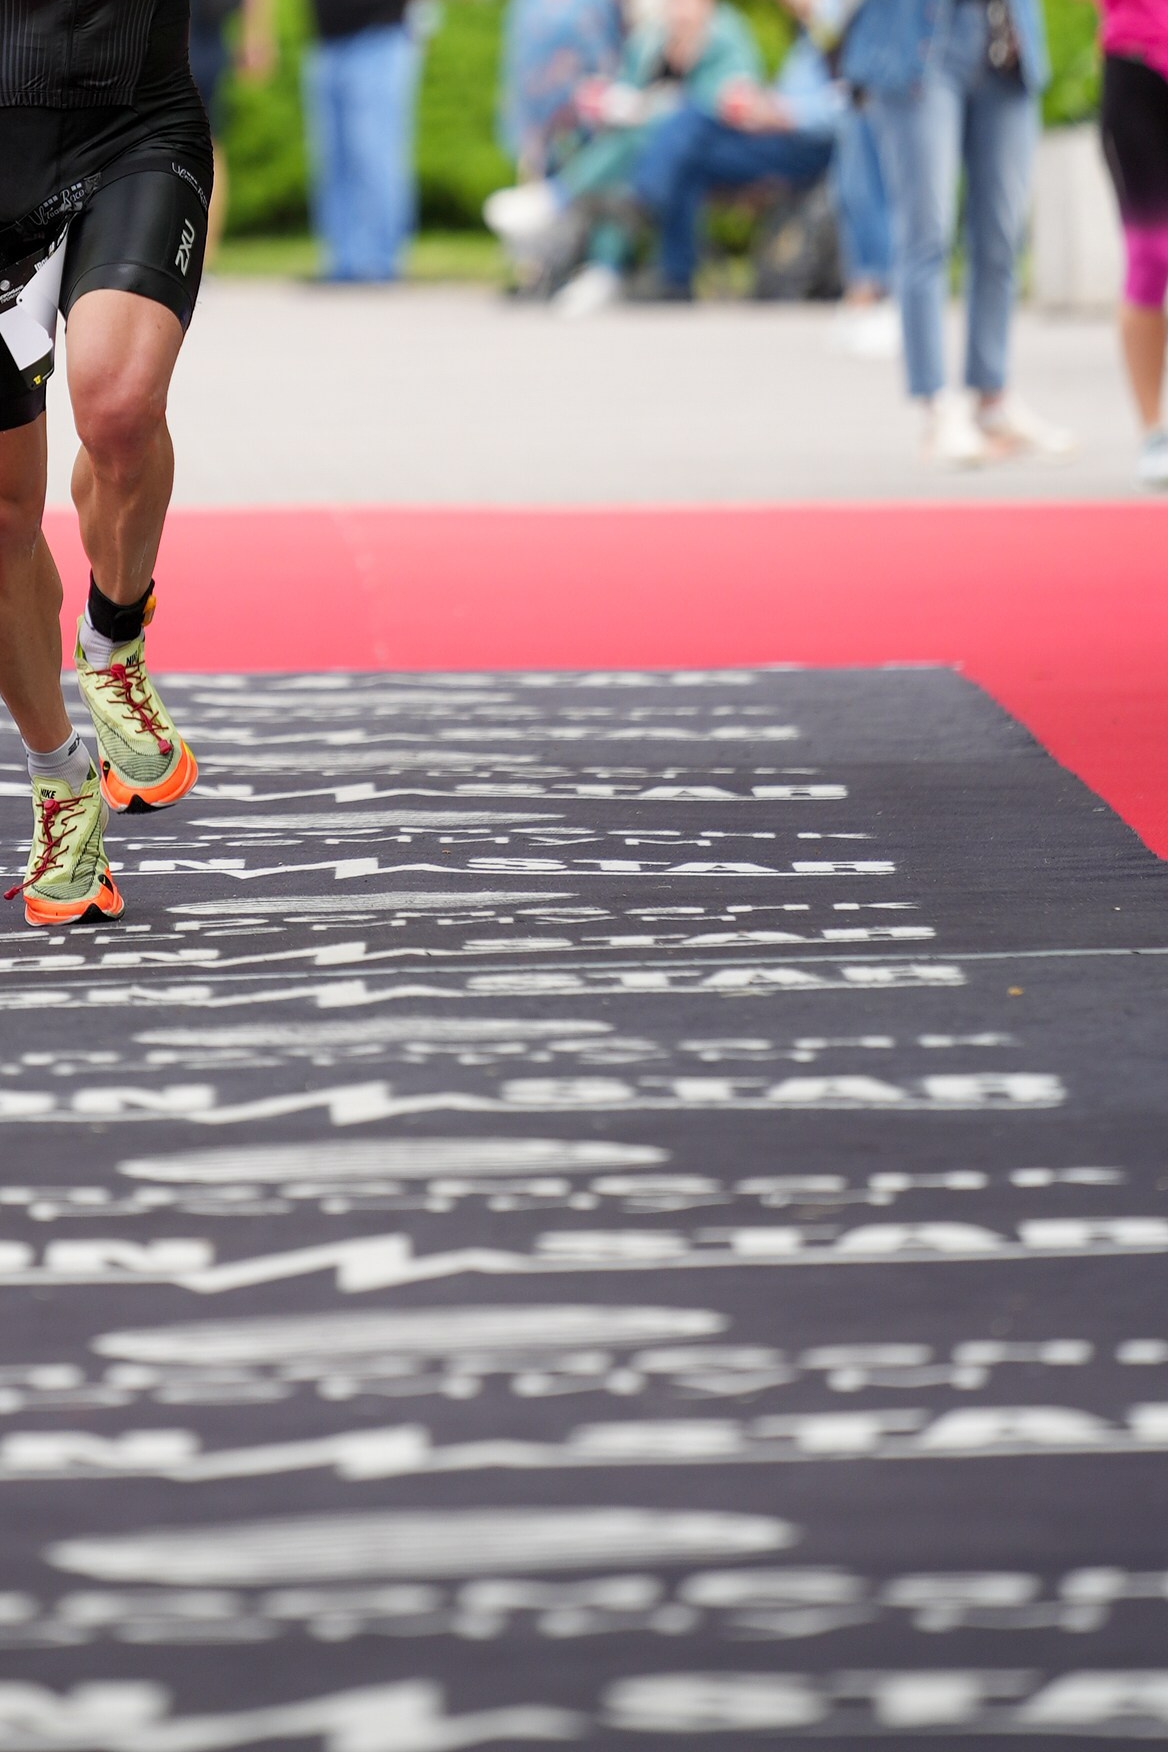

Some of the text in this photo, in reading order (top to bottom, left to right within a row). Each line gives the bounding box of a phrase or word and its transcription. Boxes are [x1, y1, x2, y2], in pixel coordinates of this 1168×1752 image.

[175, 218, 196, 276] 2XU
[40, 788, 56, 799] NIKE
[455, 783, 847, 798] STAR
[466, 858, 896, 873] STAR
[463, 926, 935, 950] STAR
[466, 964, 962, 990] STAR
[500, 1072, 1064, 1104] STAR
[567, 1401, 1168, 1458] STA
